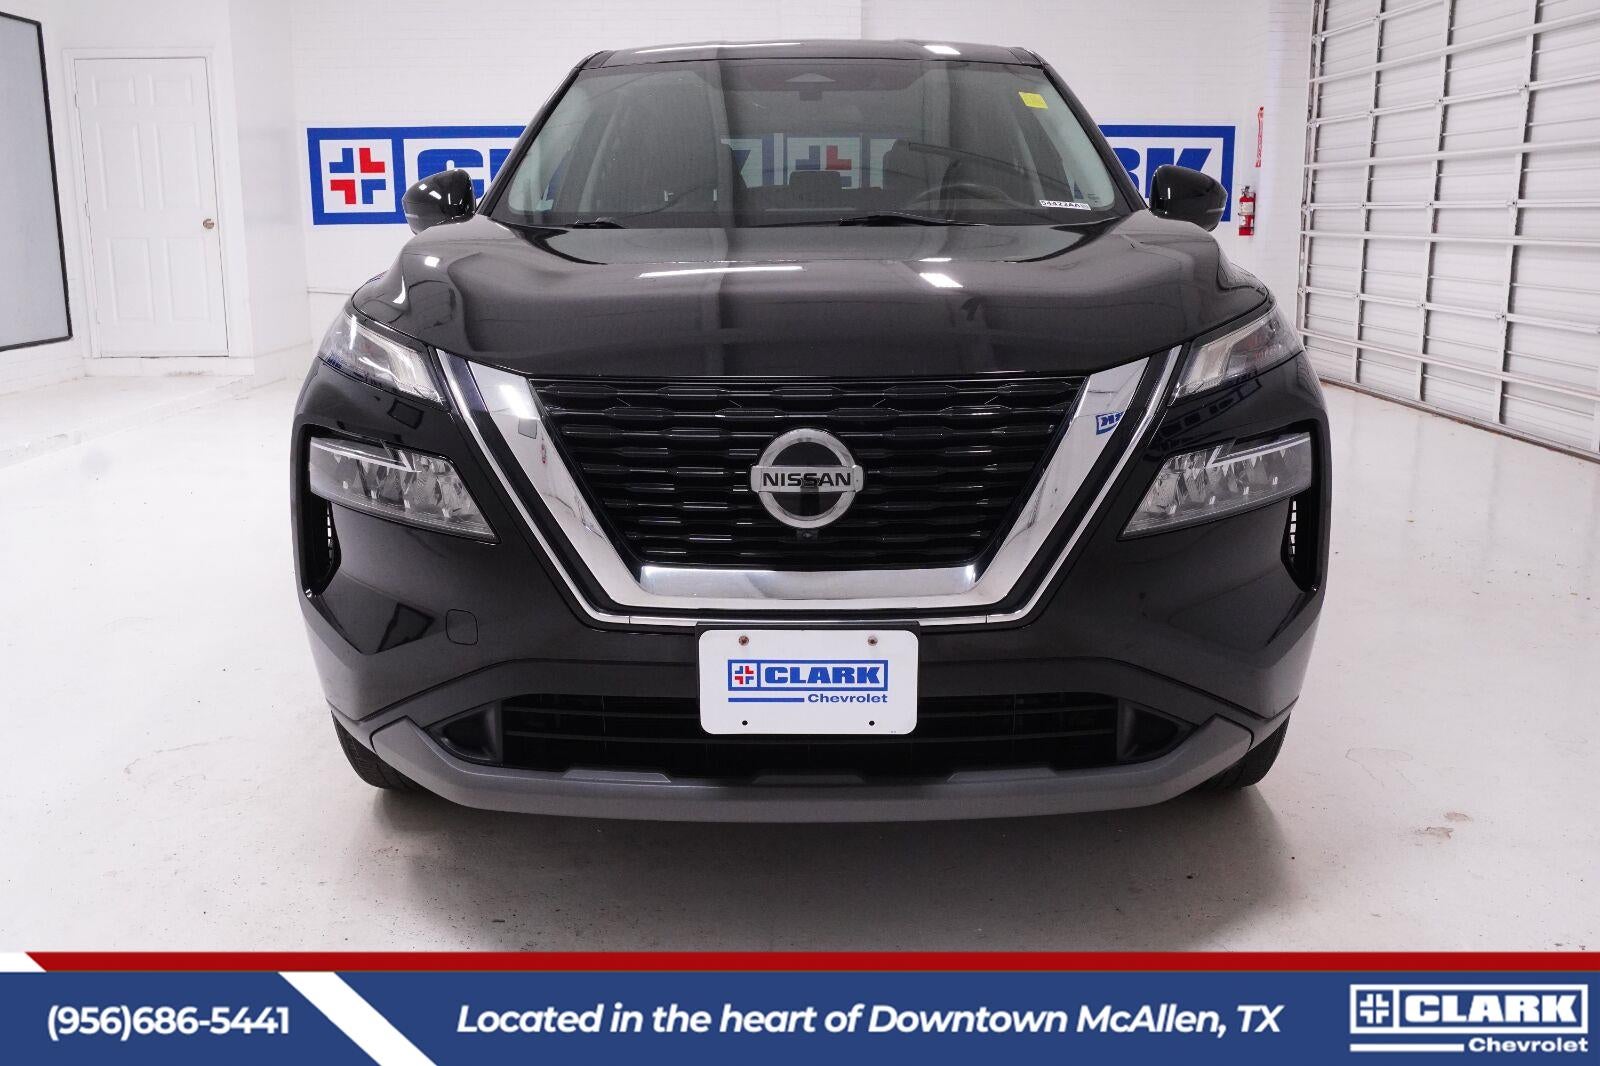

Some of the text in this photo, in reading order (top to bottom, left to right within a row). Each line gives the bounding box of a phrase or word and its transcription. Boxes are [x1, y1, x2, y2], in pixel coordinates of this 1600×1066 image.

[762, 472, 851, 487] NISSAN
[764, 666, 880, 684] CLARK
[807, 693, 888, 704] Chevrolet
